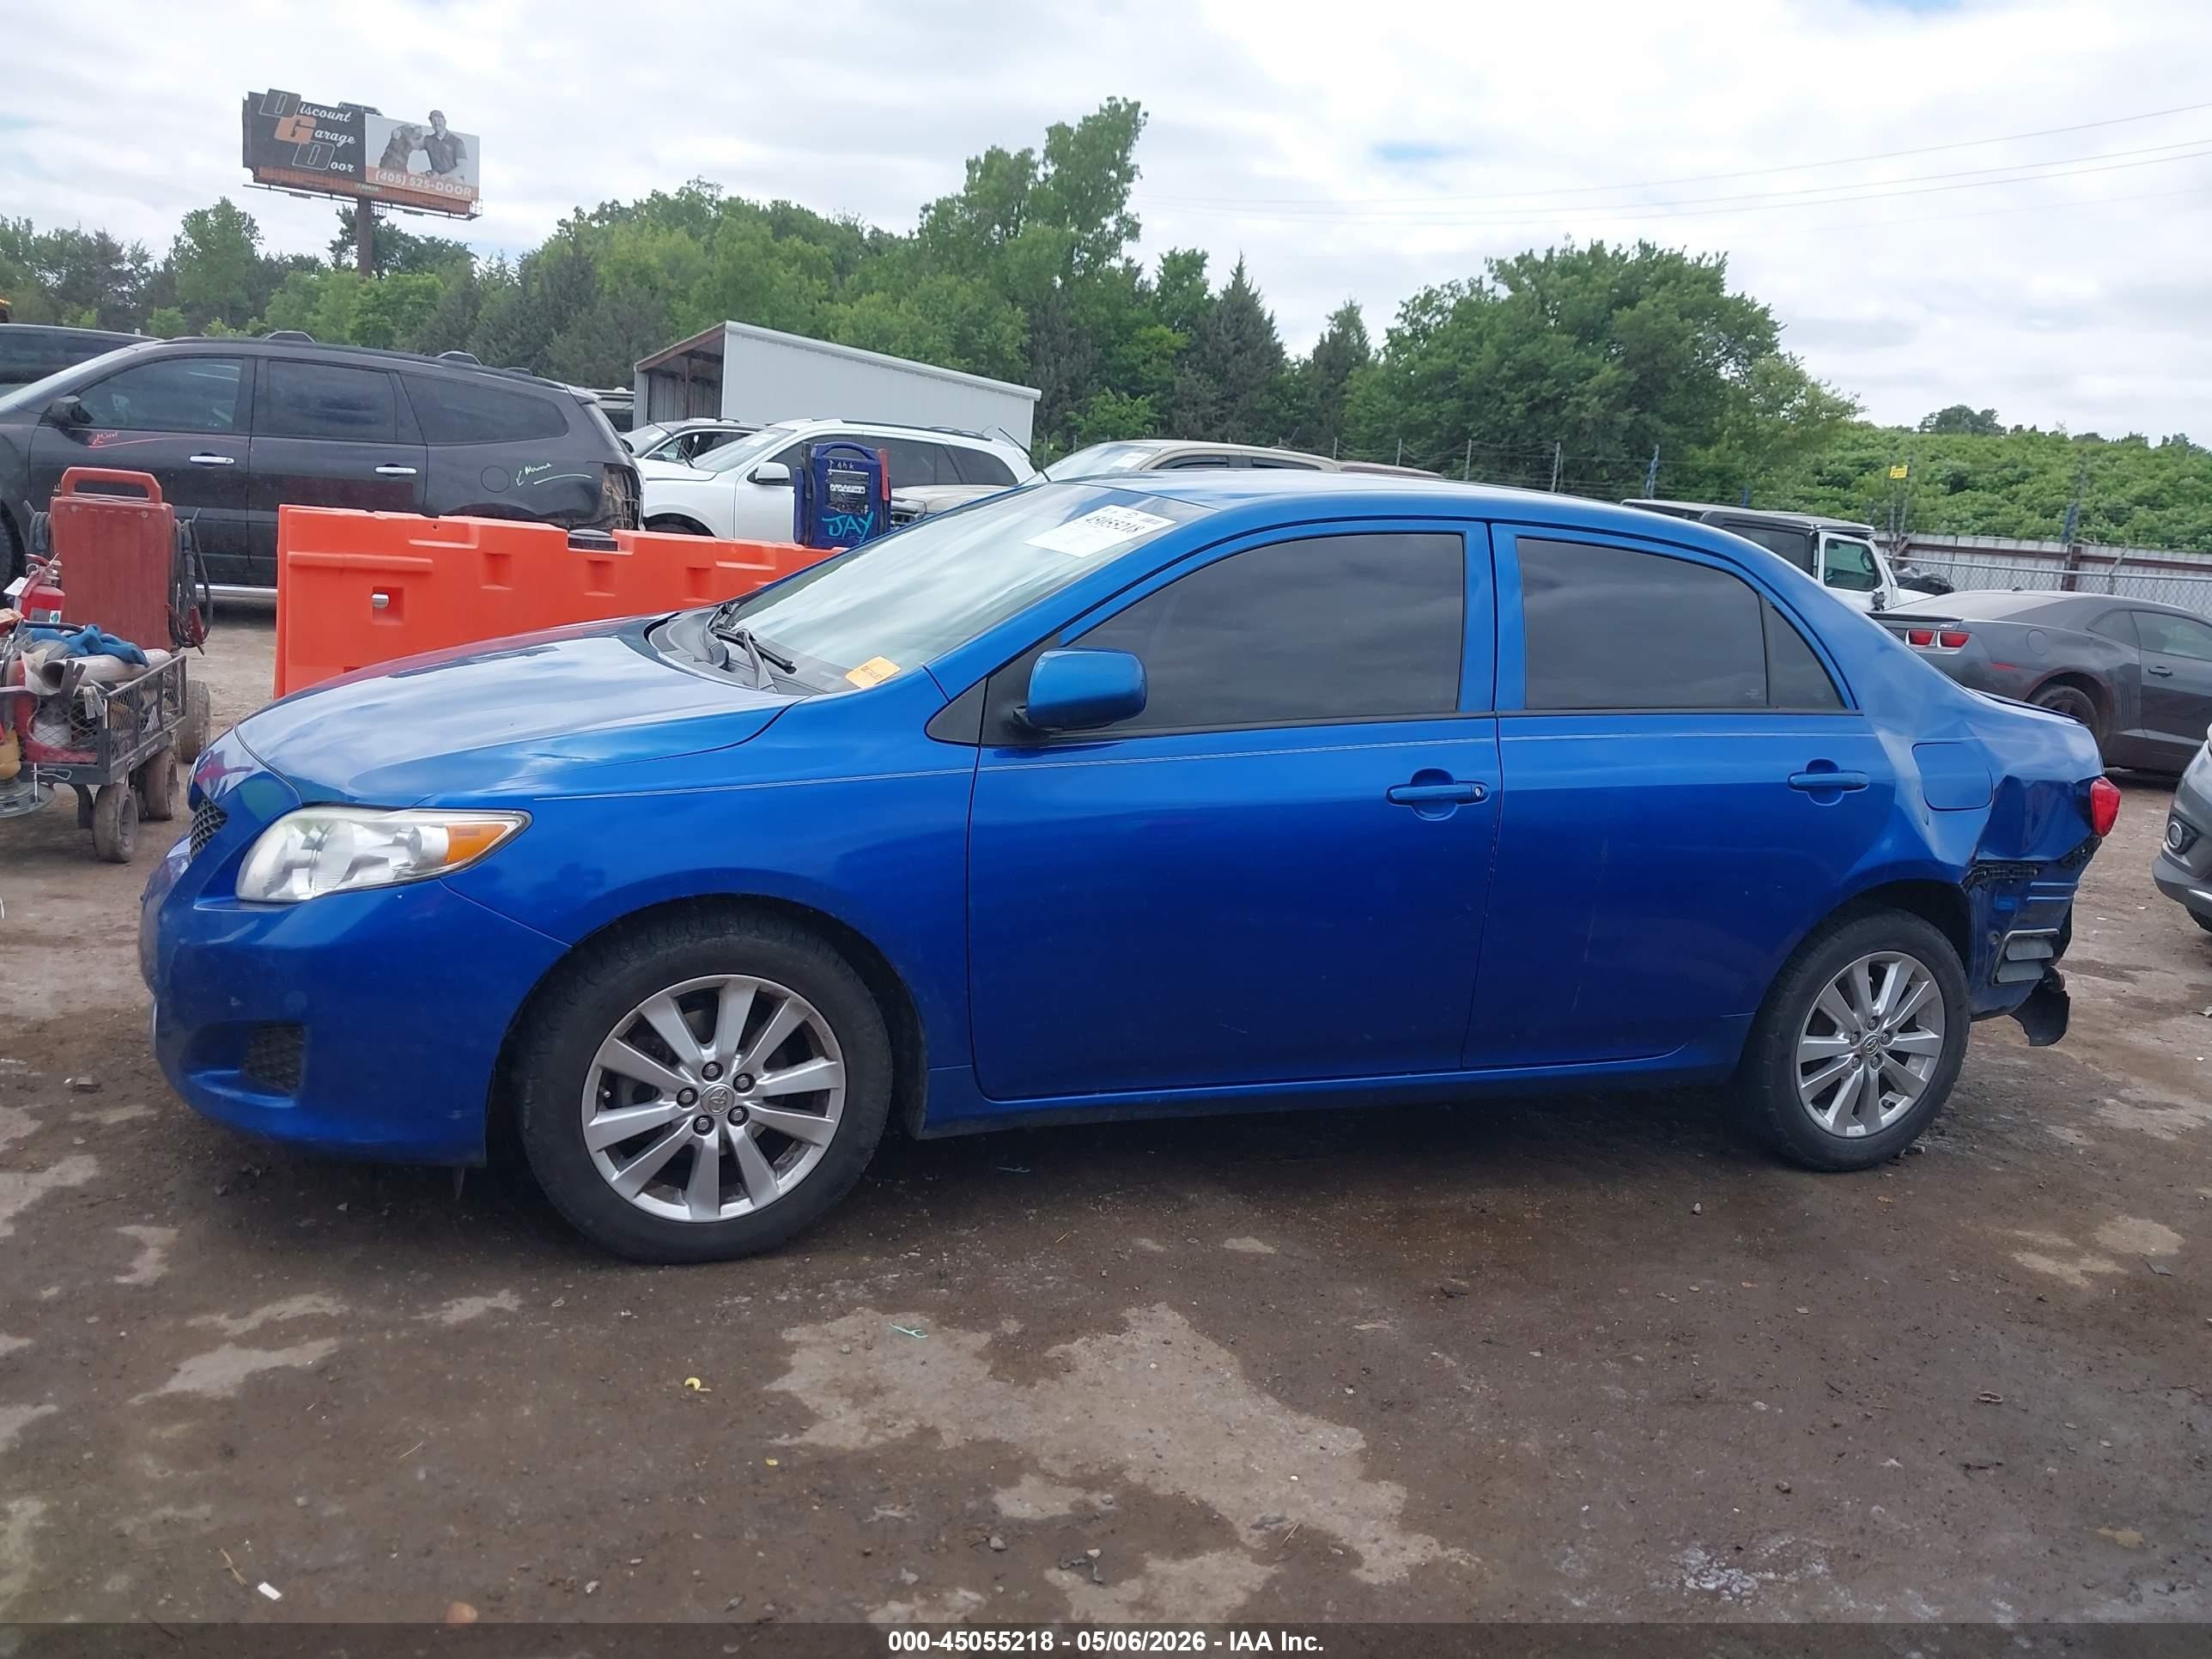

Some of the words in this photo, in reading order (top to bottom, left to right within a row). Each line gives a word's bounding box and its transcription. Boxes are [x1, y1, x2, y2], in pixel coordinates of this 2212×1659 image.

[258, 88, 352, 123] Discount
[274, 114, 356, 147] Garage
[292, 140, 356, 173] Door
[375, 170, 406, 185] (405)
[410, 178, 472, 198] 525-DOOR
[822, 511, 874, 544] JAY
